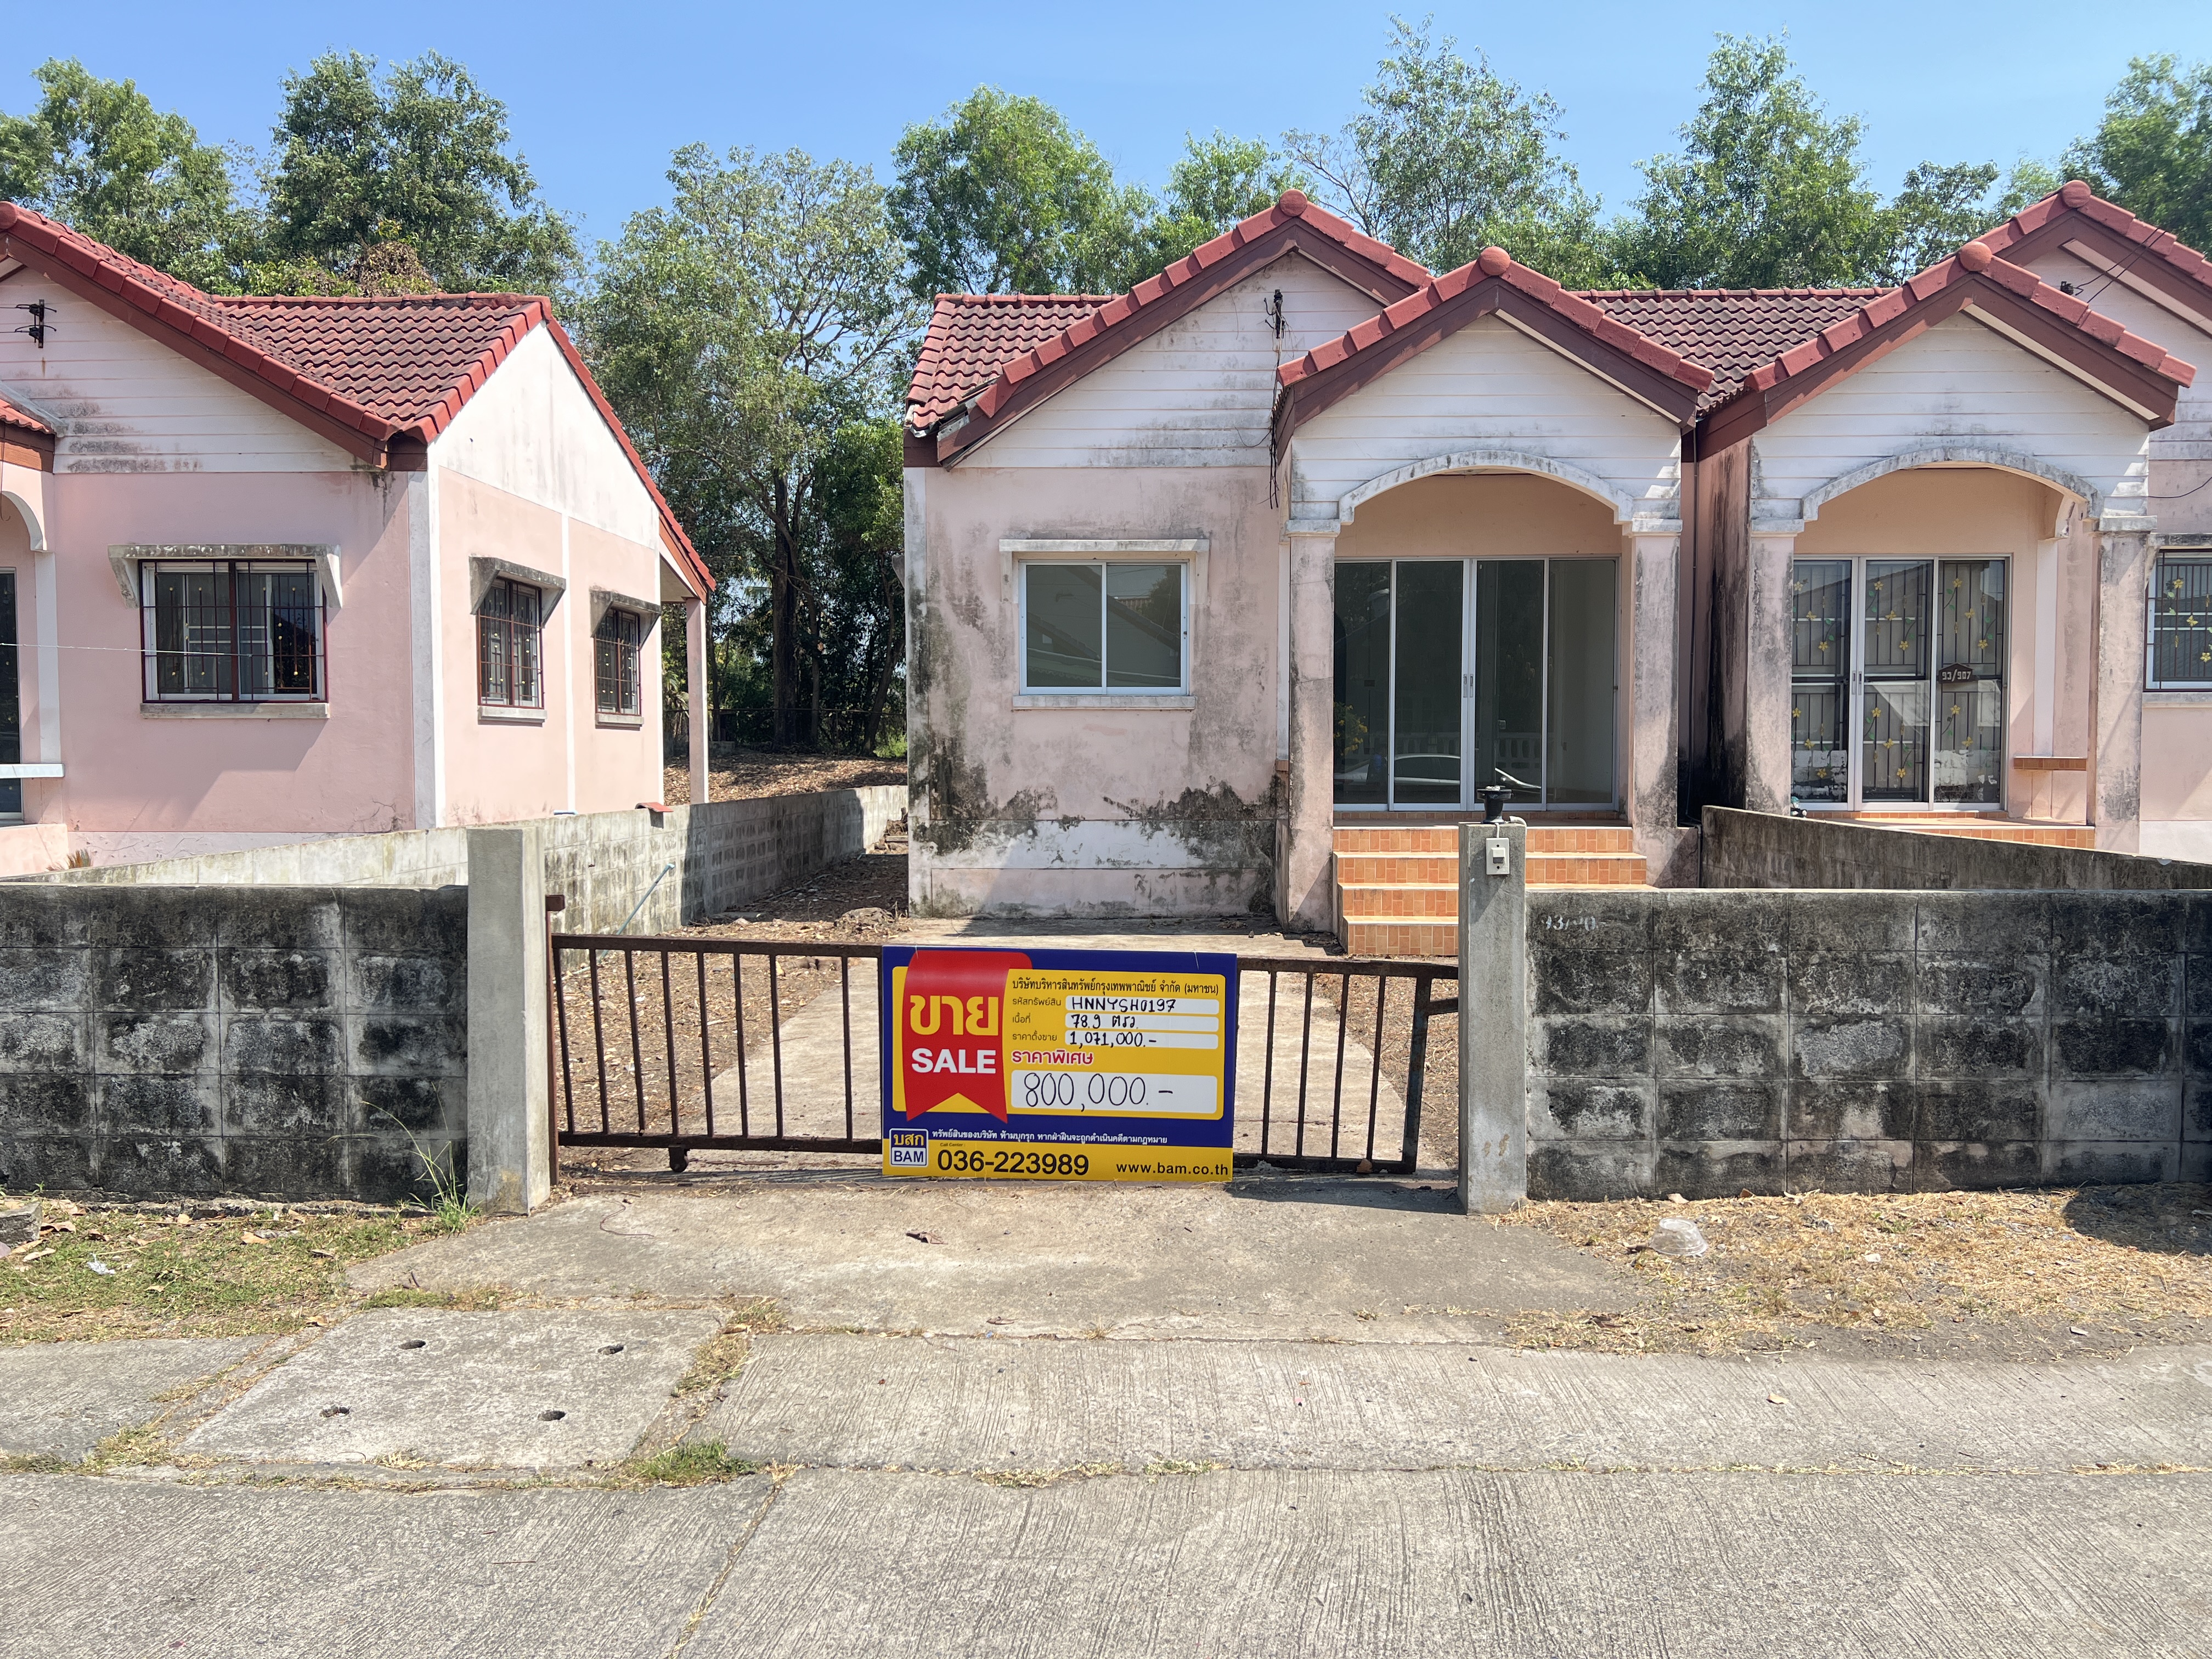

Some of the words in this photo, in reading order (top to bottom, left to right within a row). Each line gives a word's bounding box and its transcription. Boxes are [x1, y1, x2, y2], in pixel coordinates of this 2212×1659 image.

[1942, 668, 1971, 682] 93/907
[1012, 978, 1155, 995] บริษัทบริหารสินทรัพย์กรุงเทพพาณิชย์
[1160, 980, 1181, 993] จำกัด
[1184, 983, 1218, 995] (มหาชน)
[1012, 997, 1061, 1006] รหัสทรัพย์สิน
[910, 995, 1000, 1036] ขาย
[1012, 1012, 1031, 1024] เนื้อที่
[1071, 1014, 1101, 1029] 78.9
[1012, 1030, 1057, 1041] ราคาตั้งขาย
[911, 1048, 996, 1074] SALE
[1012, 1049, 1093, 1065] ราคาพิเศษ
[894, 1132, 925, 1146] บสก
[932, 1129, 997, 1139] ทรัพย์สินของบริษัท
[1000, 1131, 1035, 1143] ห้ามบุกรุก
[1037, 1132, 1168, 1145] หากฝ่าฝืนจะถูกดำเนินคดีตามกฎหมาย
[894, 1150, 924, 1163] BAM
[938, 1150, 1089, 1175] 036-223989
[1116, 1161, 1228, 1176] www.bam.co.th
